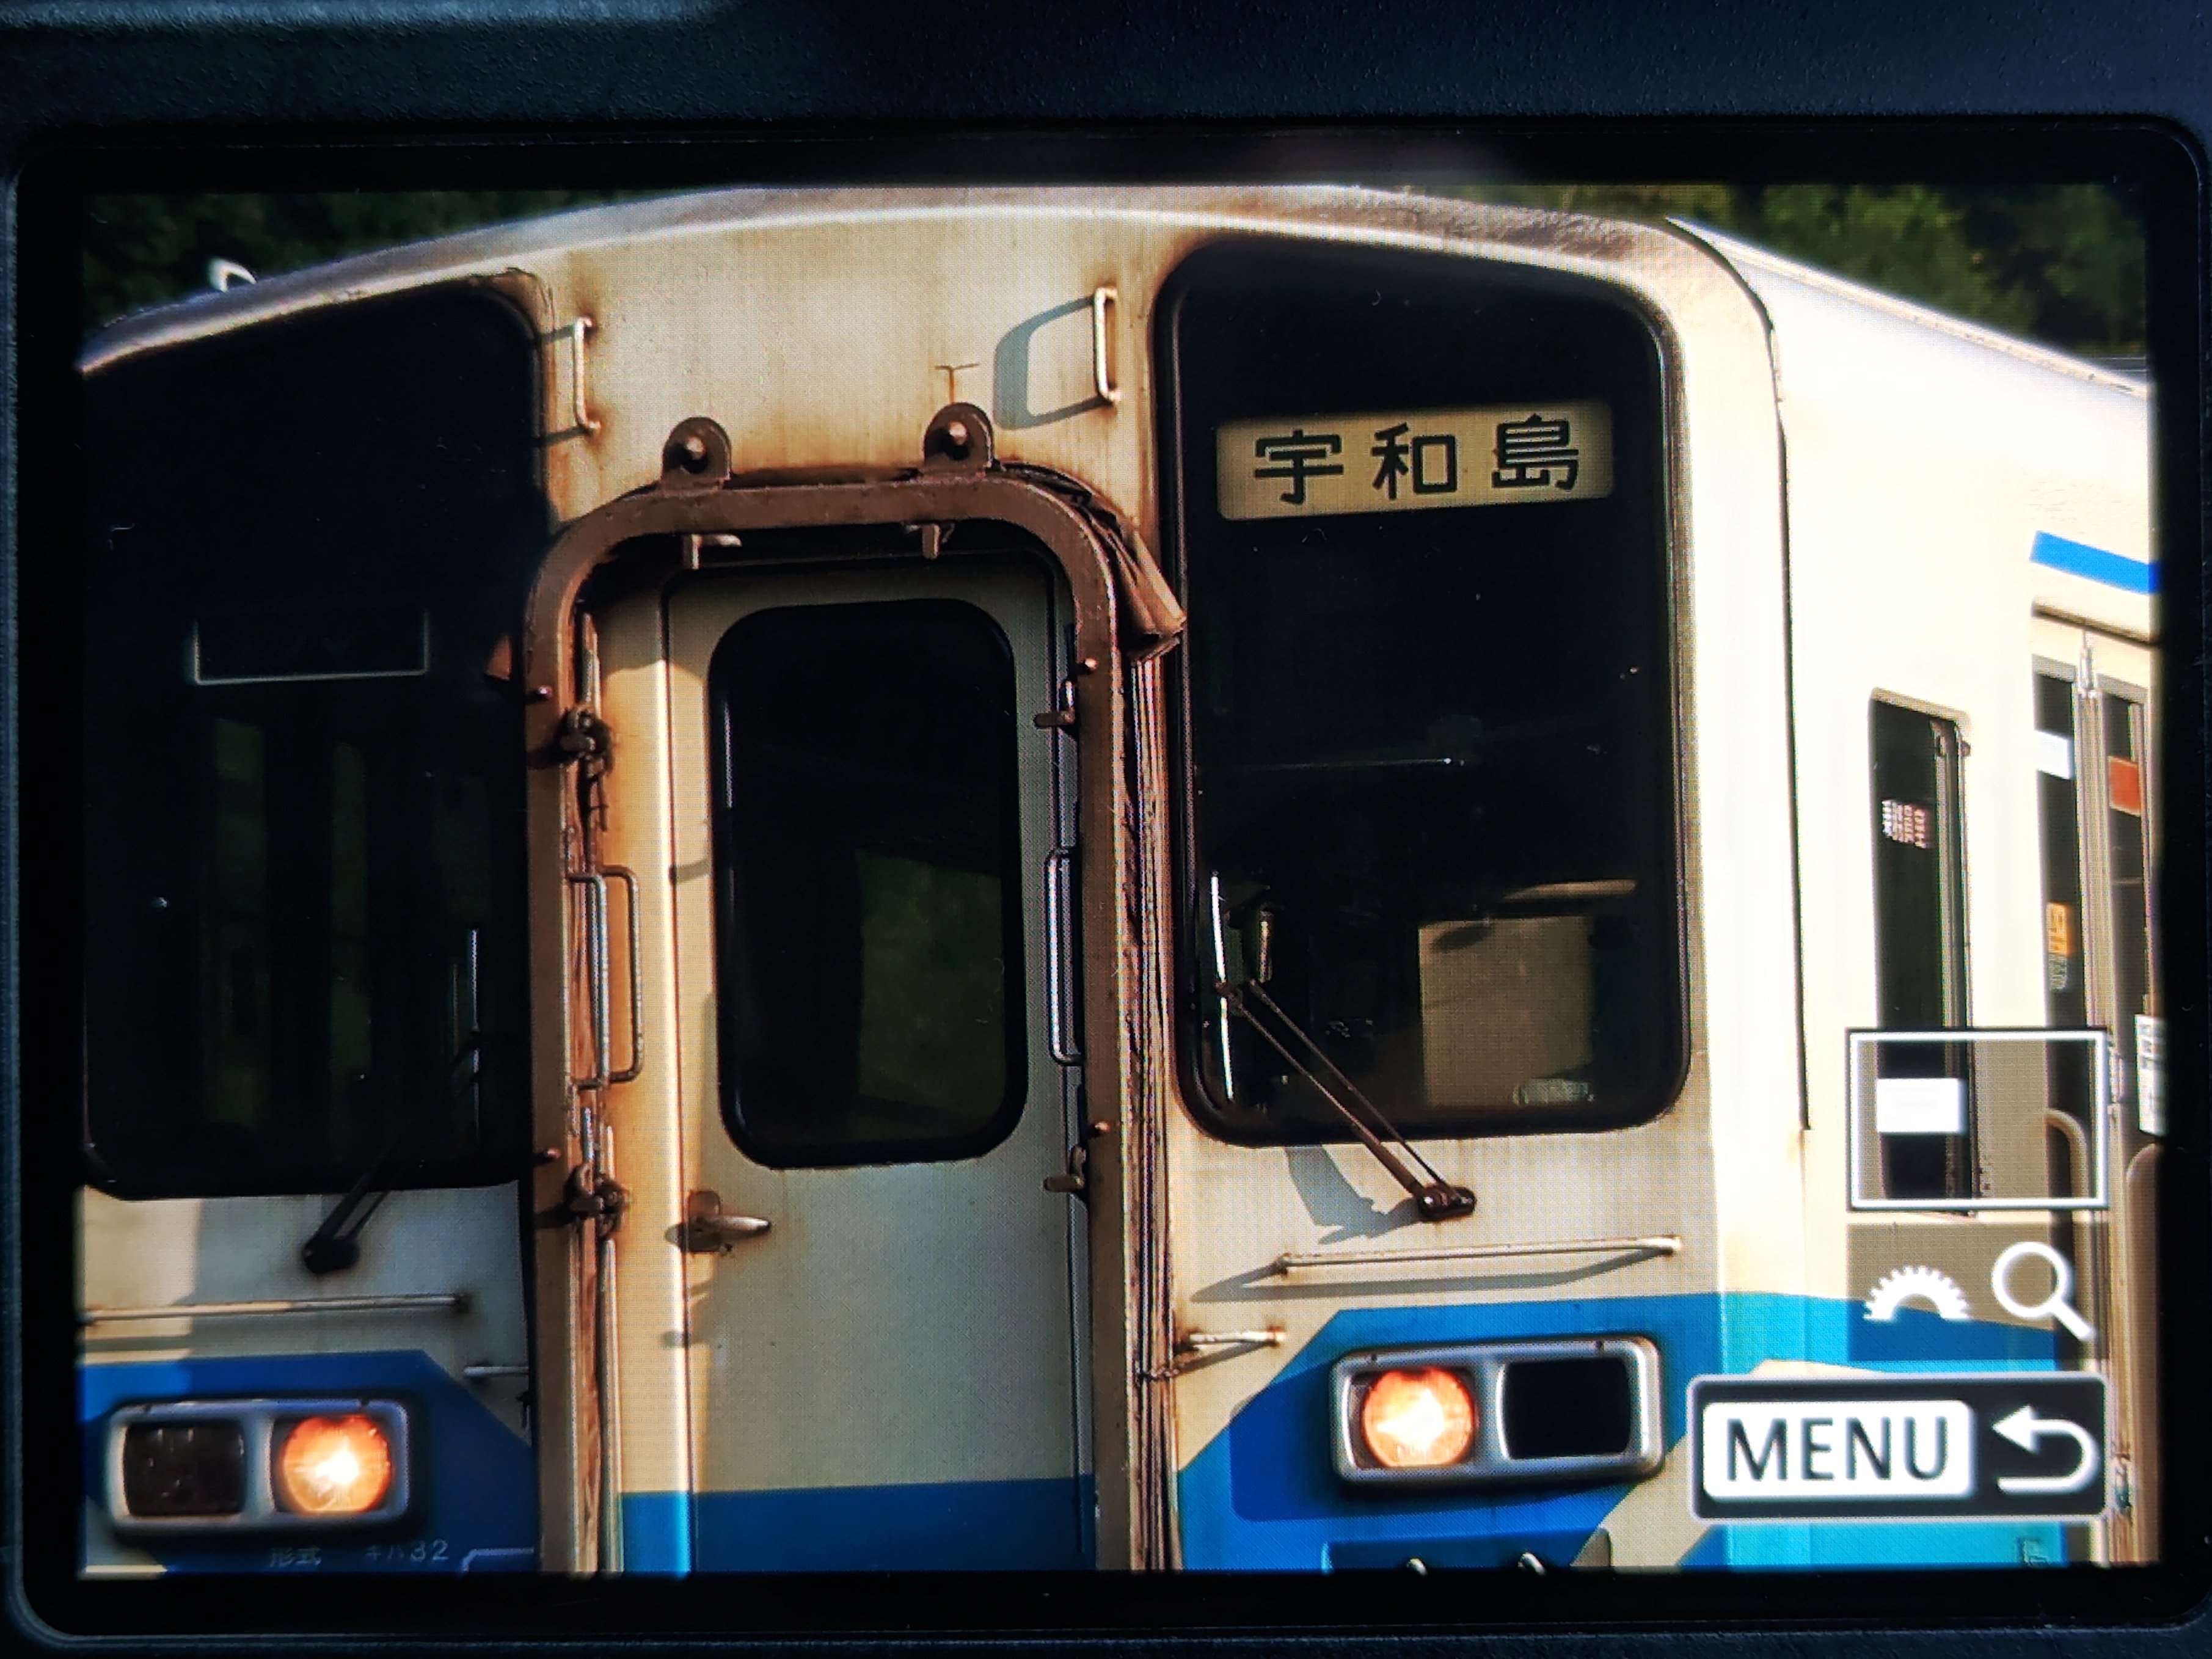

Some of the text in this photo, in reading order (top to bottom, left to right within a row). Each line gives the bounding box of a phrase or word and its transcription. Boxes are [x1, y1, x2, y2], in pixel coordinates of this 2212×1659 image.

[1254, 413, 1579, 505] 宇和島
[1726, 1415, 1949, 1482] MENU
